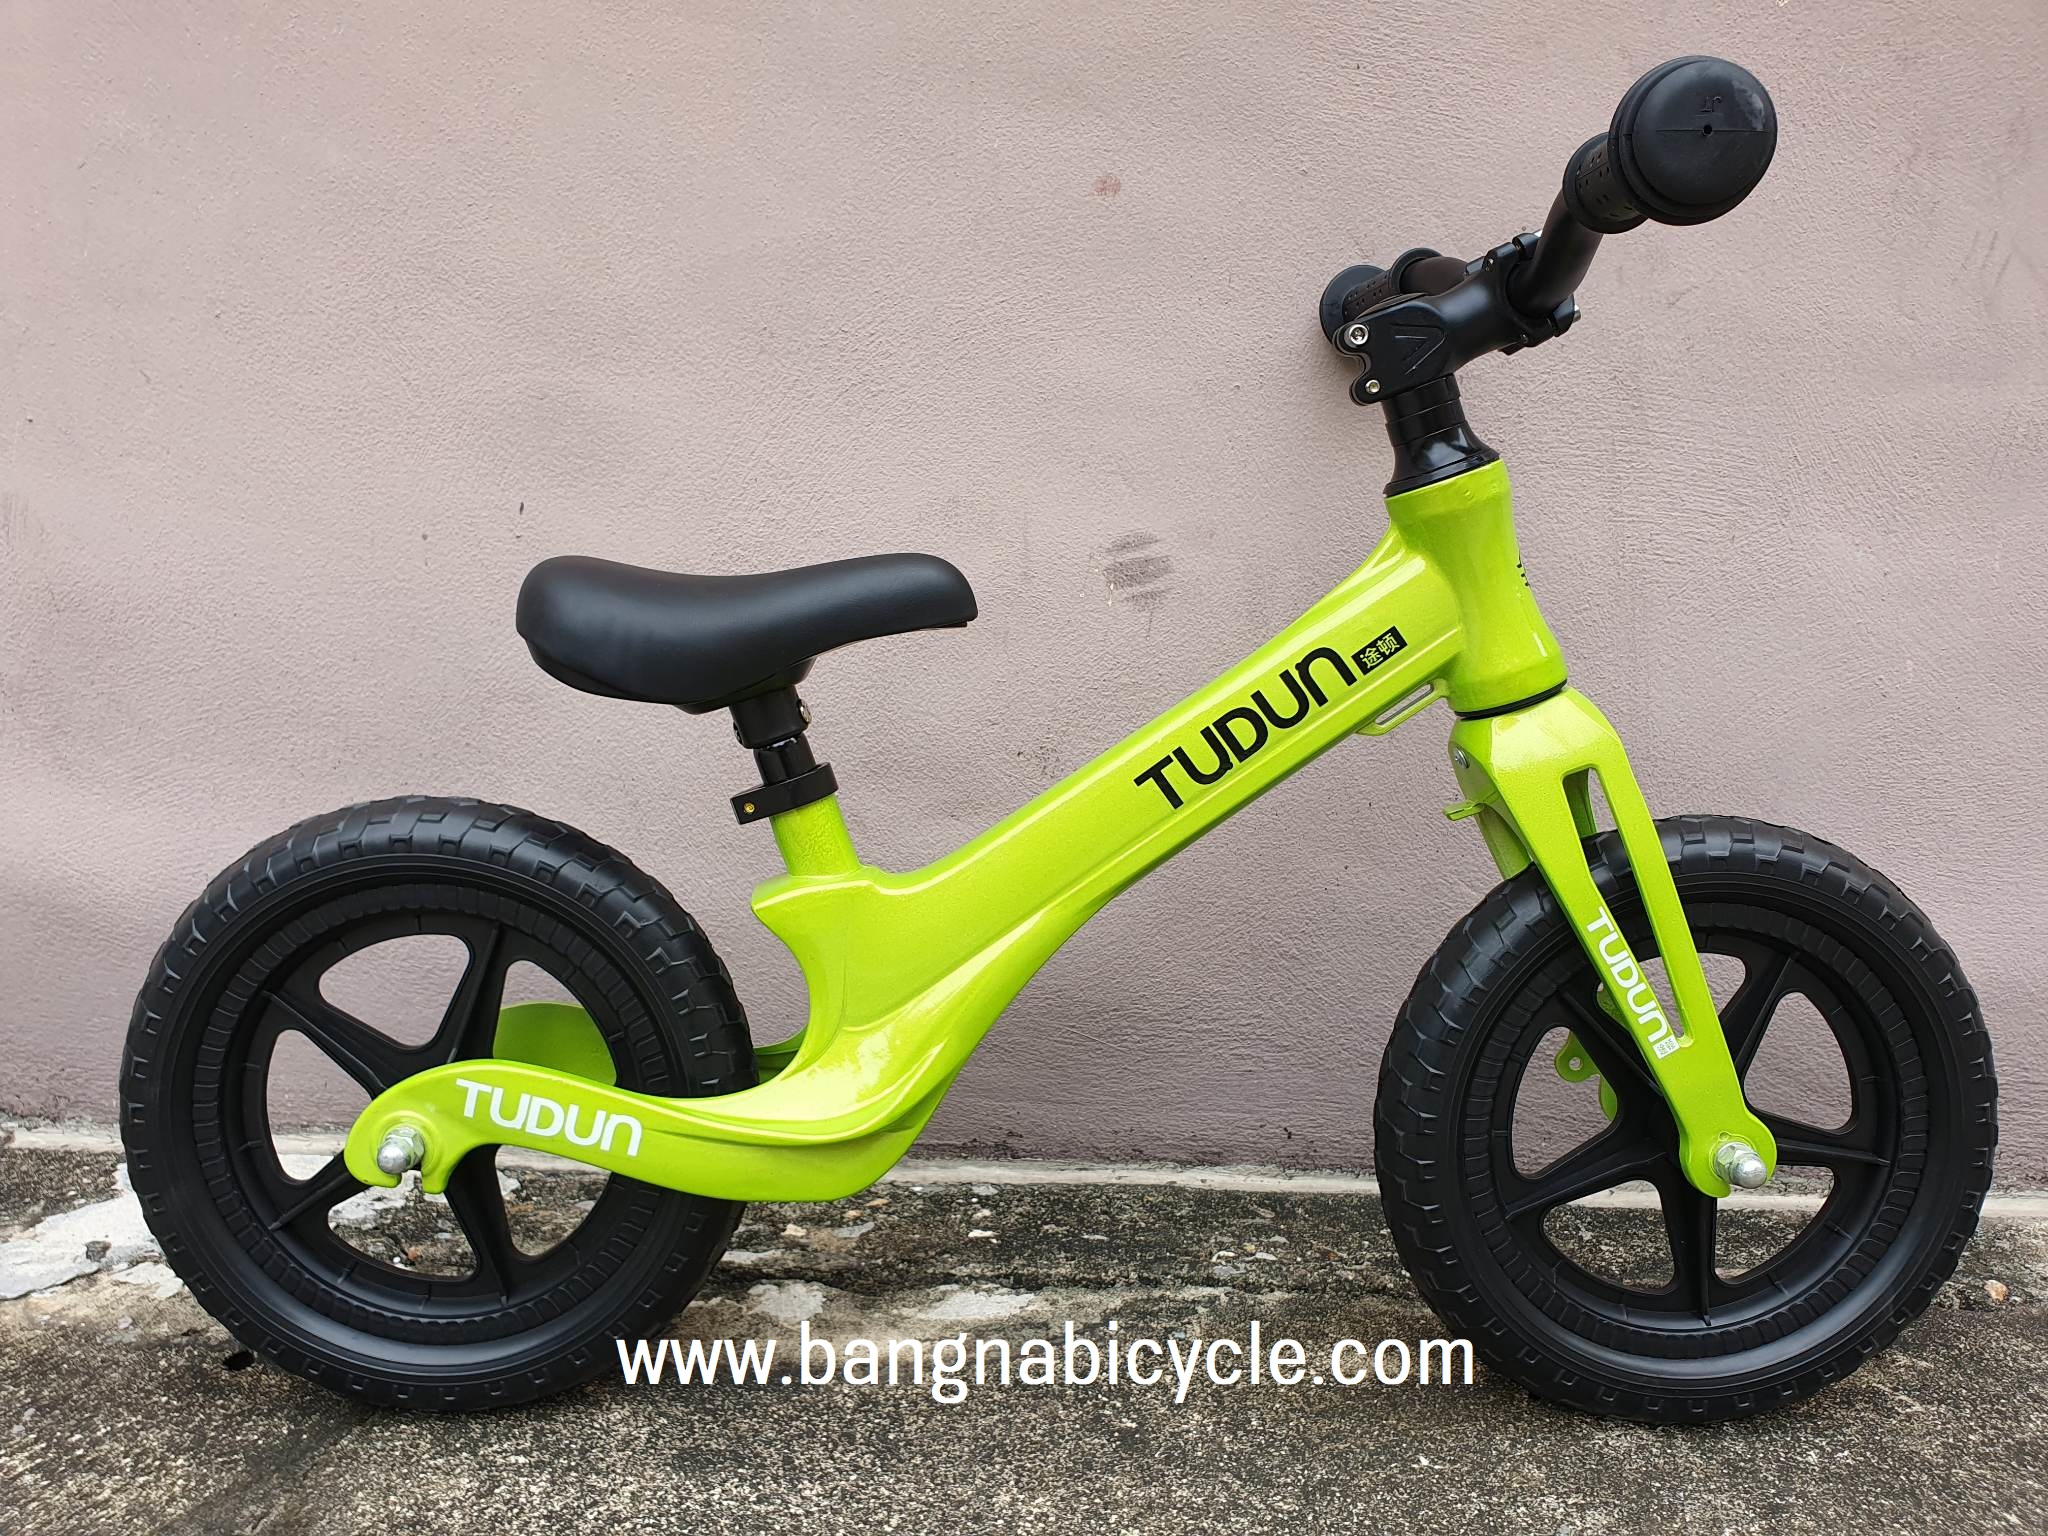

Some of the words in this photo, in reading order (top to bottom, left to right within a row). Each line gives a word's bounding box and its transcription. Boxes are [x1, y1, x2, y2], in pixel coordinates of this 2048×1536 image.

[1357, 631, 1403, 671] 途顿
[1133, 647, 1358, 810] TUDUN
[1586, 906, 1668, 1042] TUDUN
[455, 1078, 643, 1157] TUDUN
